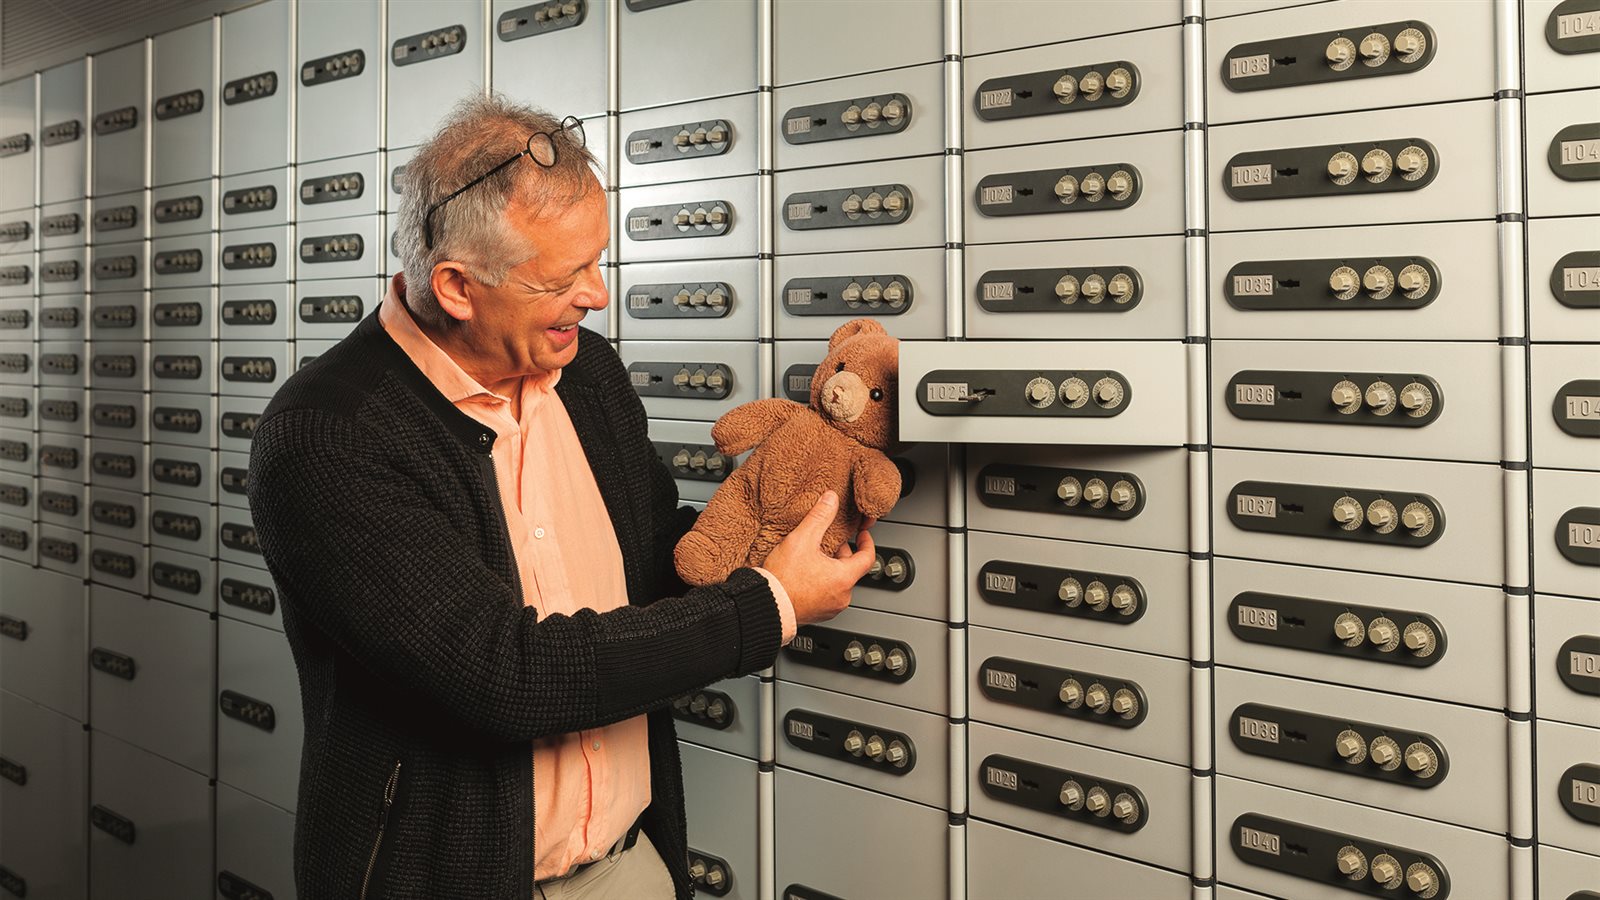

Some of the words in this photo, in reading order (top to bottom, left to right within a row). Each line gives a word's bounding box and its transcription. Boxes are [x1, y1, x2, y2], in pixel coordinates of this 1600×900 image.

[1561, 15, 1600, 35] 104
[1233, 57, 1268, 76] 1033
[983, 91, 1010, 107] 1022
[631, 141, 649, 154] 1002
[1234, 167, 1270, 184] 1034
[983, 187, 1011, 201] 1023
[631, 218, 649, 229] 1003
[985, 284, 1012, 299] 1024
[1235, 277, 1271, 293] 1035
[929, 386, 966, 400] 1025
[1237, 387, 1273, 403] 1036
[987, 479, 1014, 493] 1026
[1239, 497, 1275, 515] 1037
[987, 575, 1015, 591] 1027
[1239, 608, 1277, 627] 1038
[1573, 655, 1600, 673] 10
[988, 671, 1016, 689] 1028
[790, 720, 813, 737] 1020
[1241, 718, 1278, 741] 1039
[988, 768, 1016, 788] 1029
[1242, 826, 1280, 853] 1040
